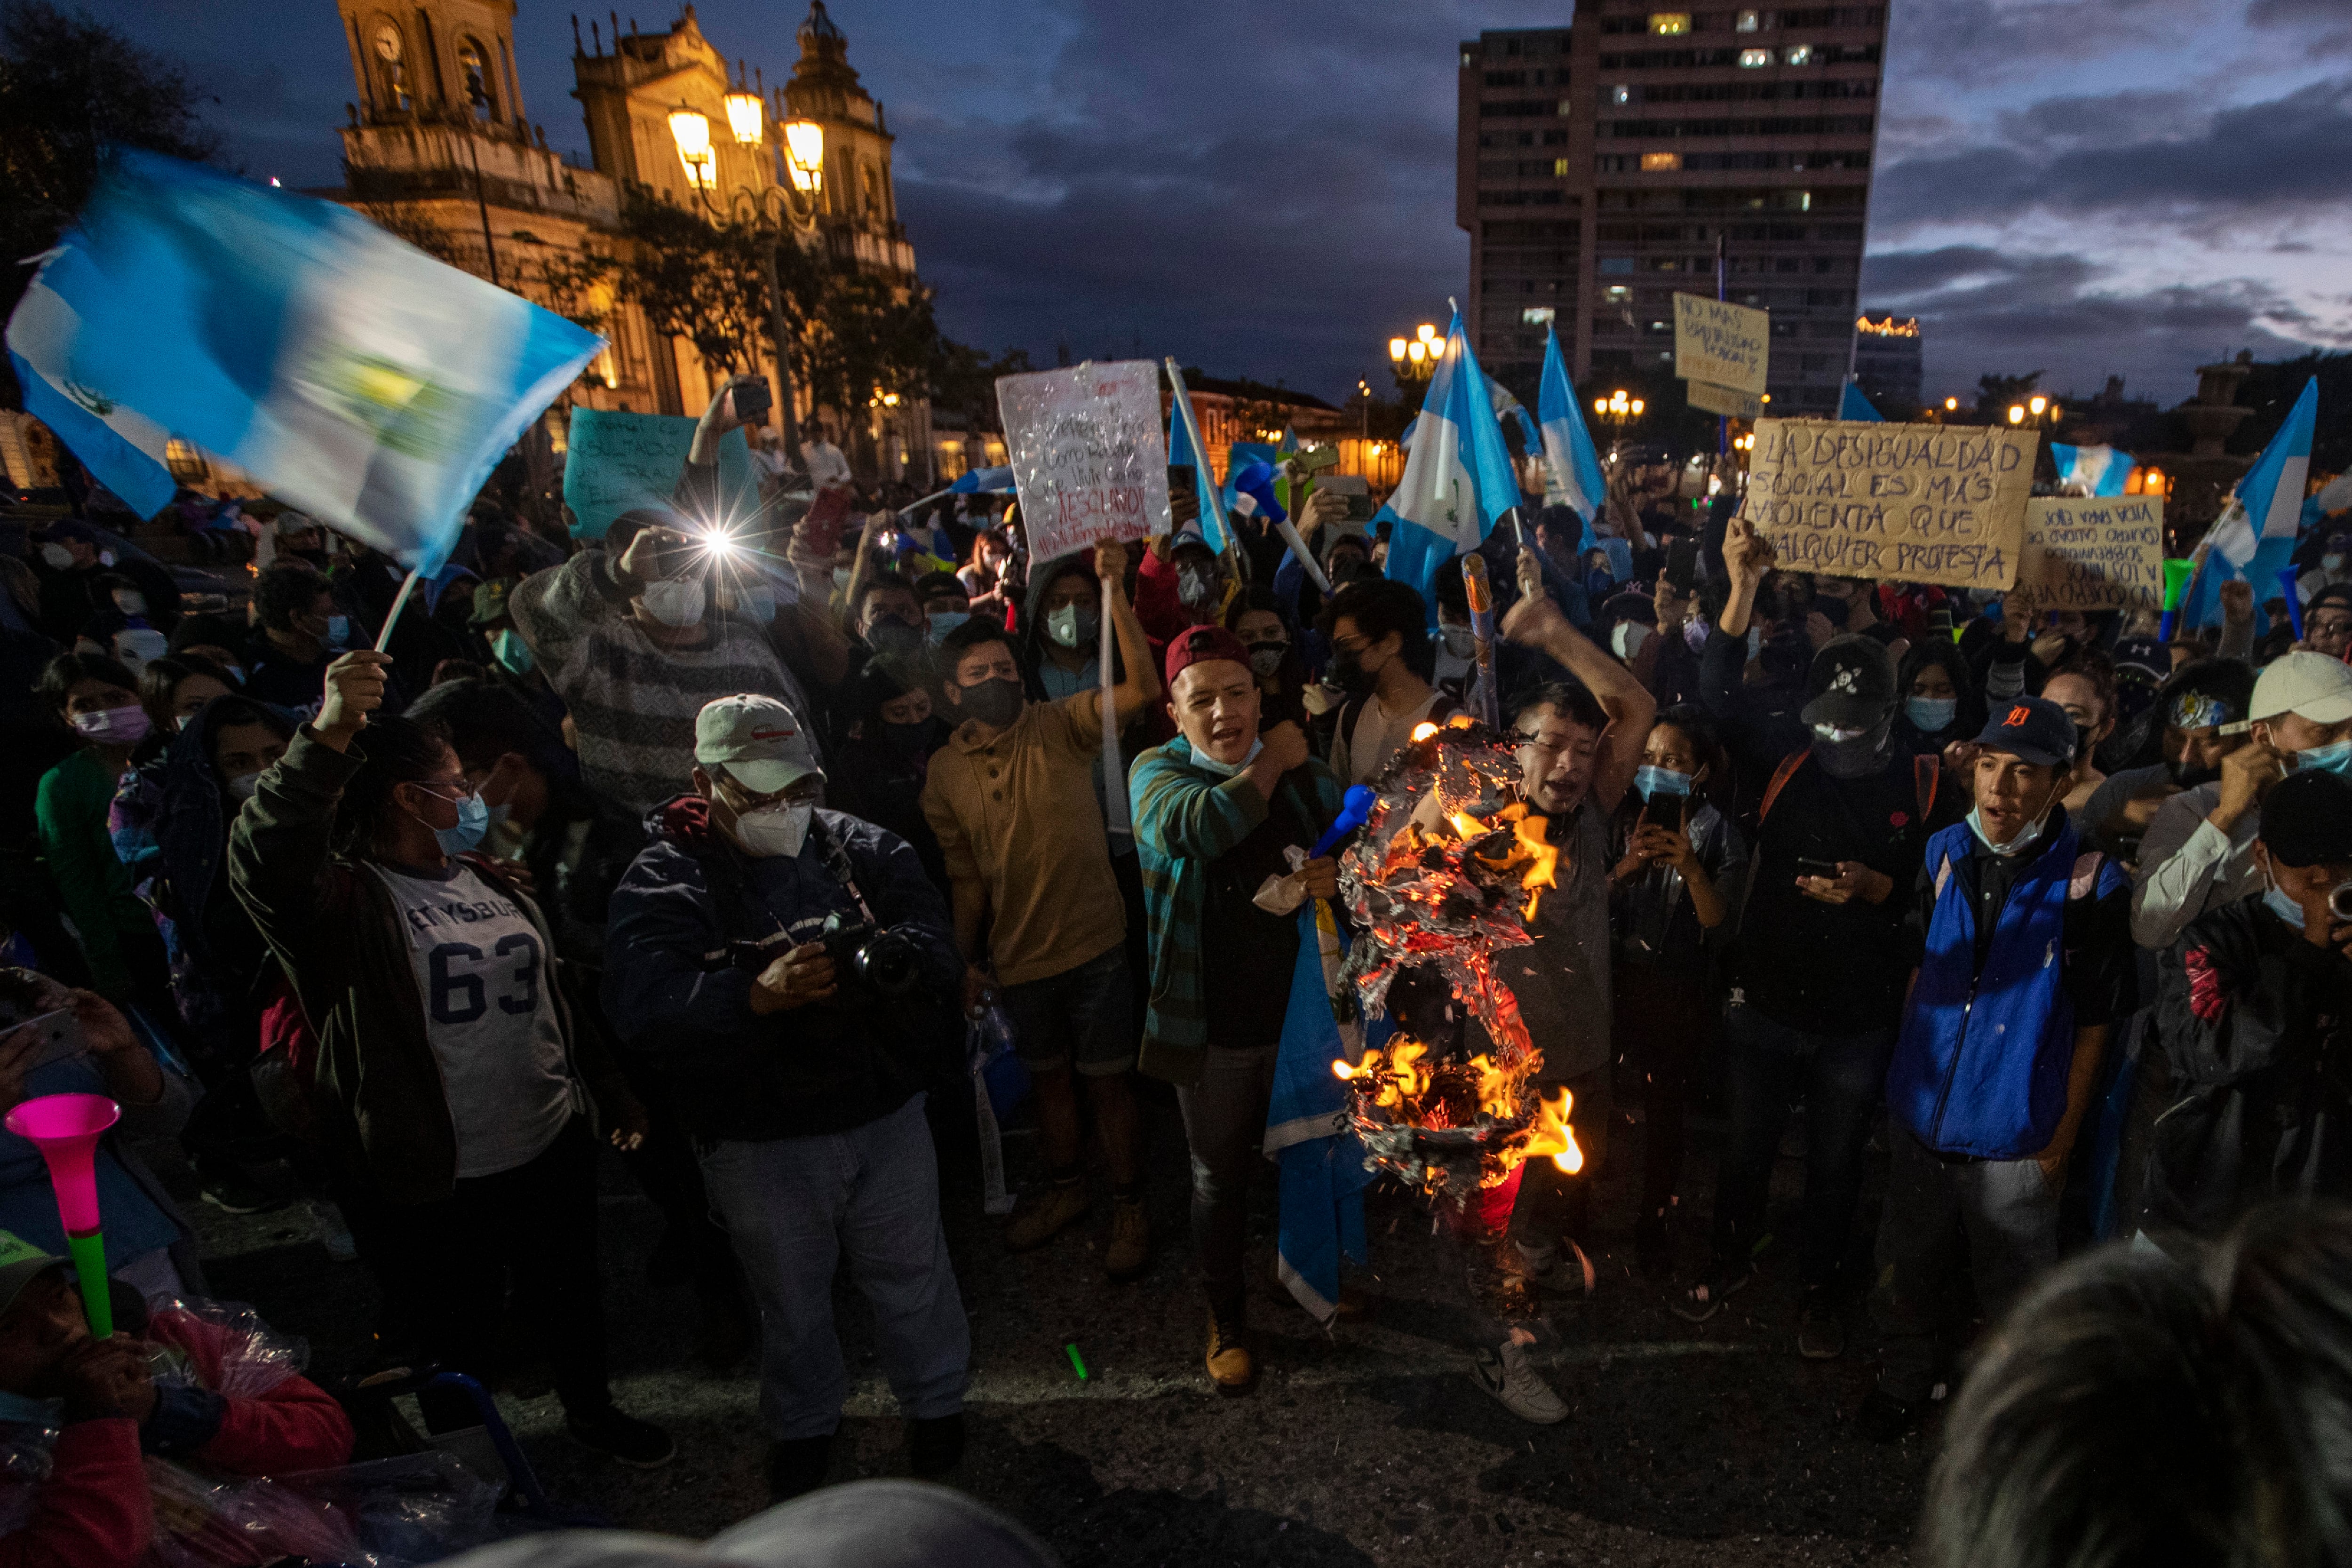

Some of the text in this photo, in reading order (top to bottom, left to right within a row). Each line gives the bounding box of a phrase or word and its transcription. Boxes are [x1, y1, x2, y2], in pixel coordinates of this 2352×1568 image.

[1765, 434, 2020, 471] LA DESIGUALDAD
[1755, 471, 1851, 499] SOCIAL
[1870, 475, 1907, 499] ES
[1753, 501, 1973, 536] VIOLENTA QUE
[1755, 528, 2005, 579] ALQUIER PROTESTA
[428, 932, 539, 1025] 63
